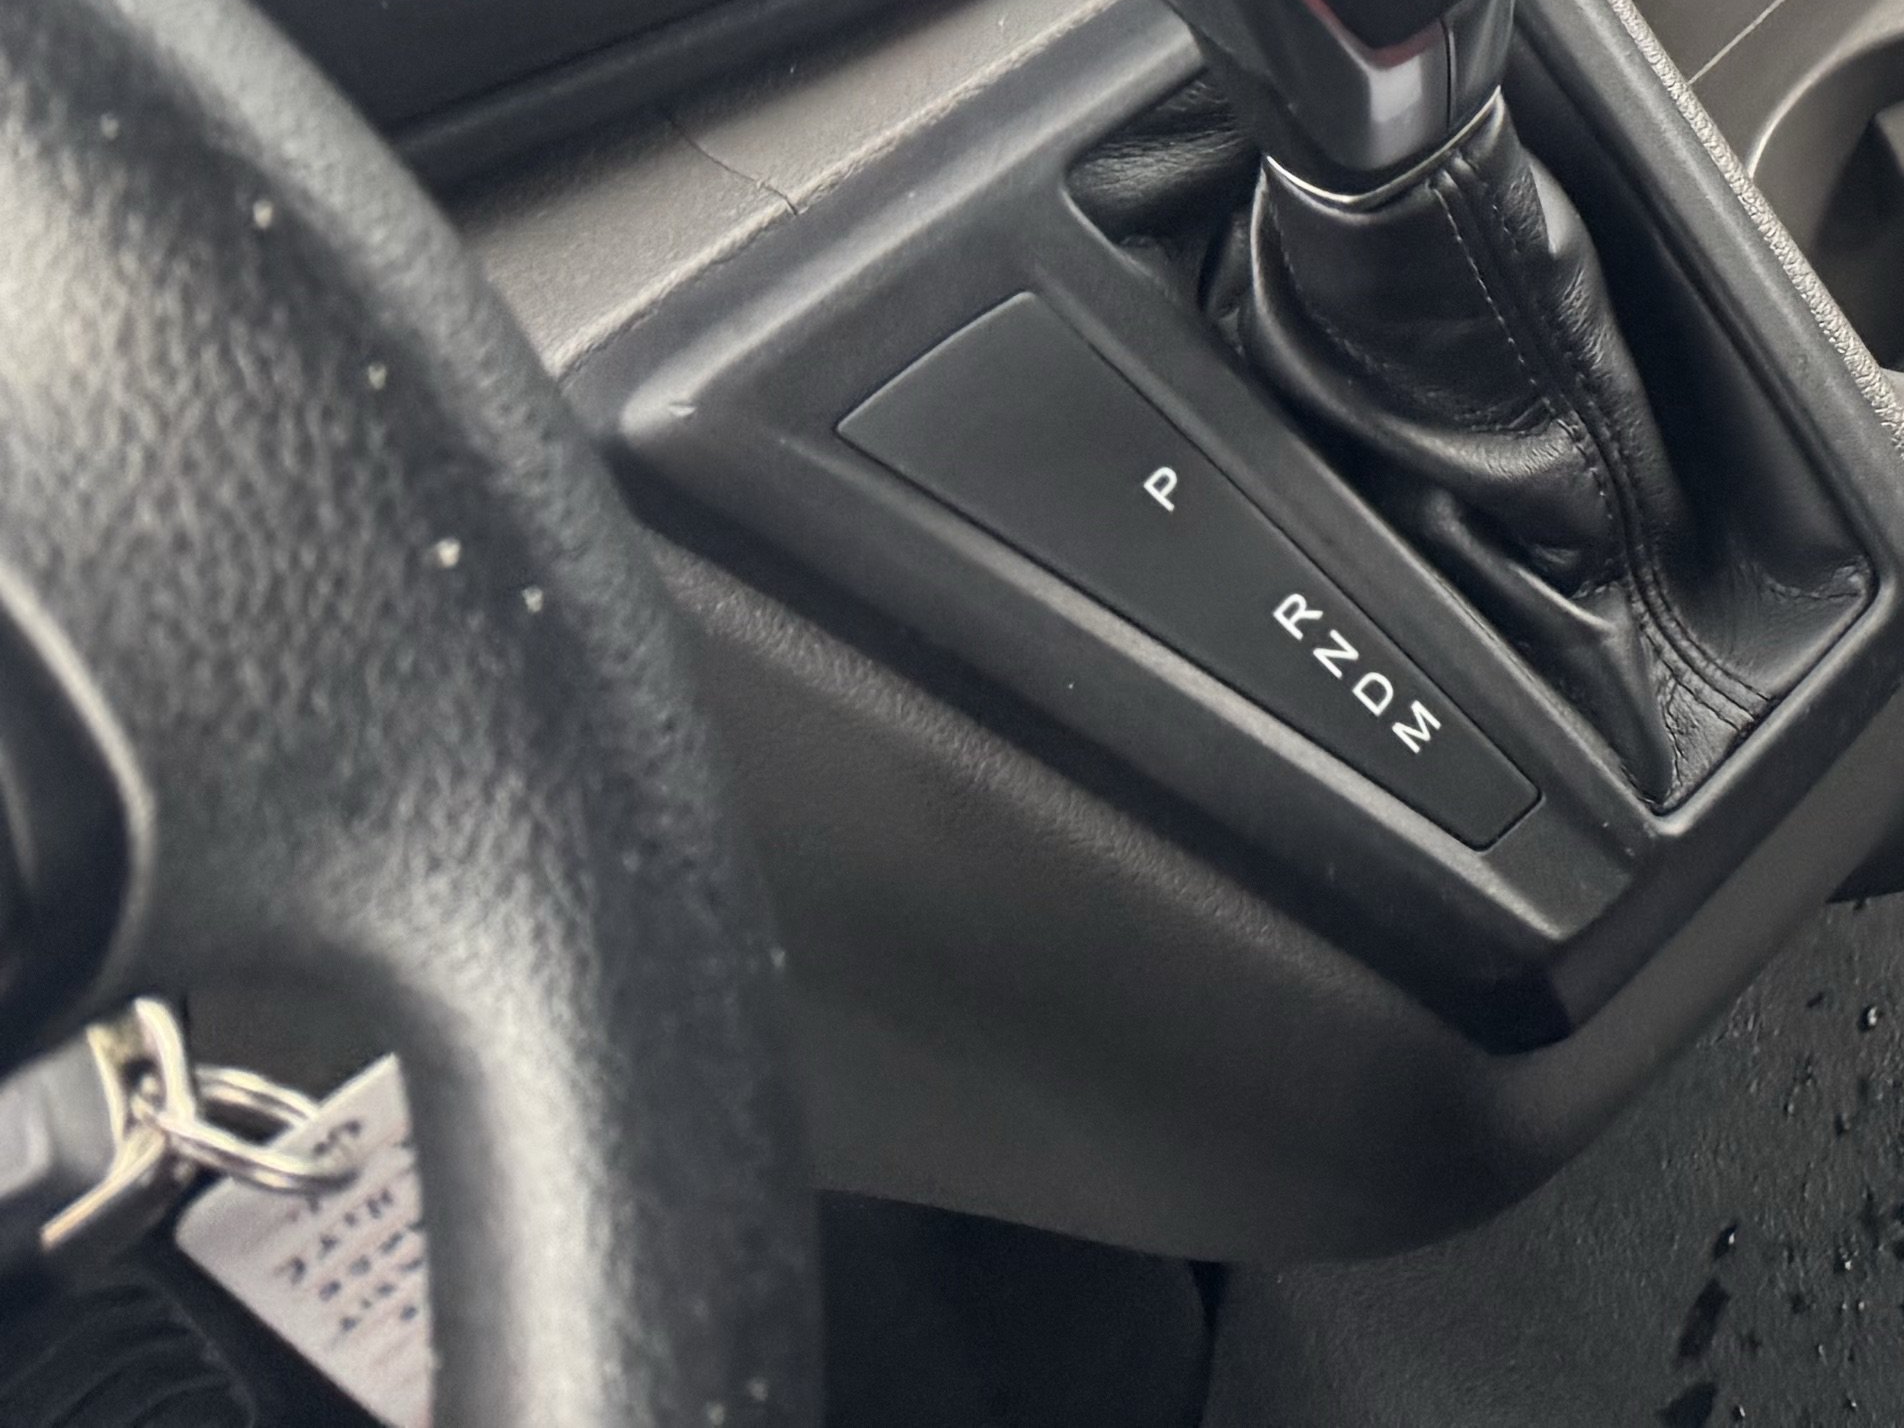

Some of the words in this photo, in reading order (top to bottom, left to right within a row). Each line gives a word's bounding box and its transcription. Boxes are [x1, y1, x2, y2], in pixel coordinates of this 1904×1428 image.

[1143, 466, 1177, 511] P
[1273, 593, 1324, 641] R
[1312, 629, 1360, 680] N
[1352, 672, 1394, 717] D
[1391, 700, 1442, 754] M
